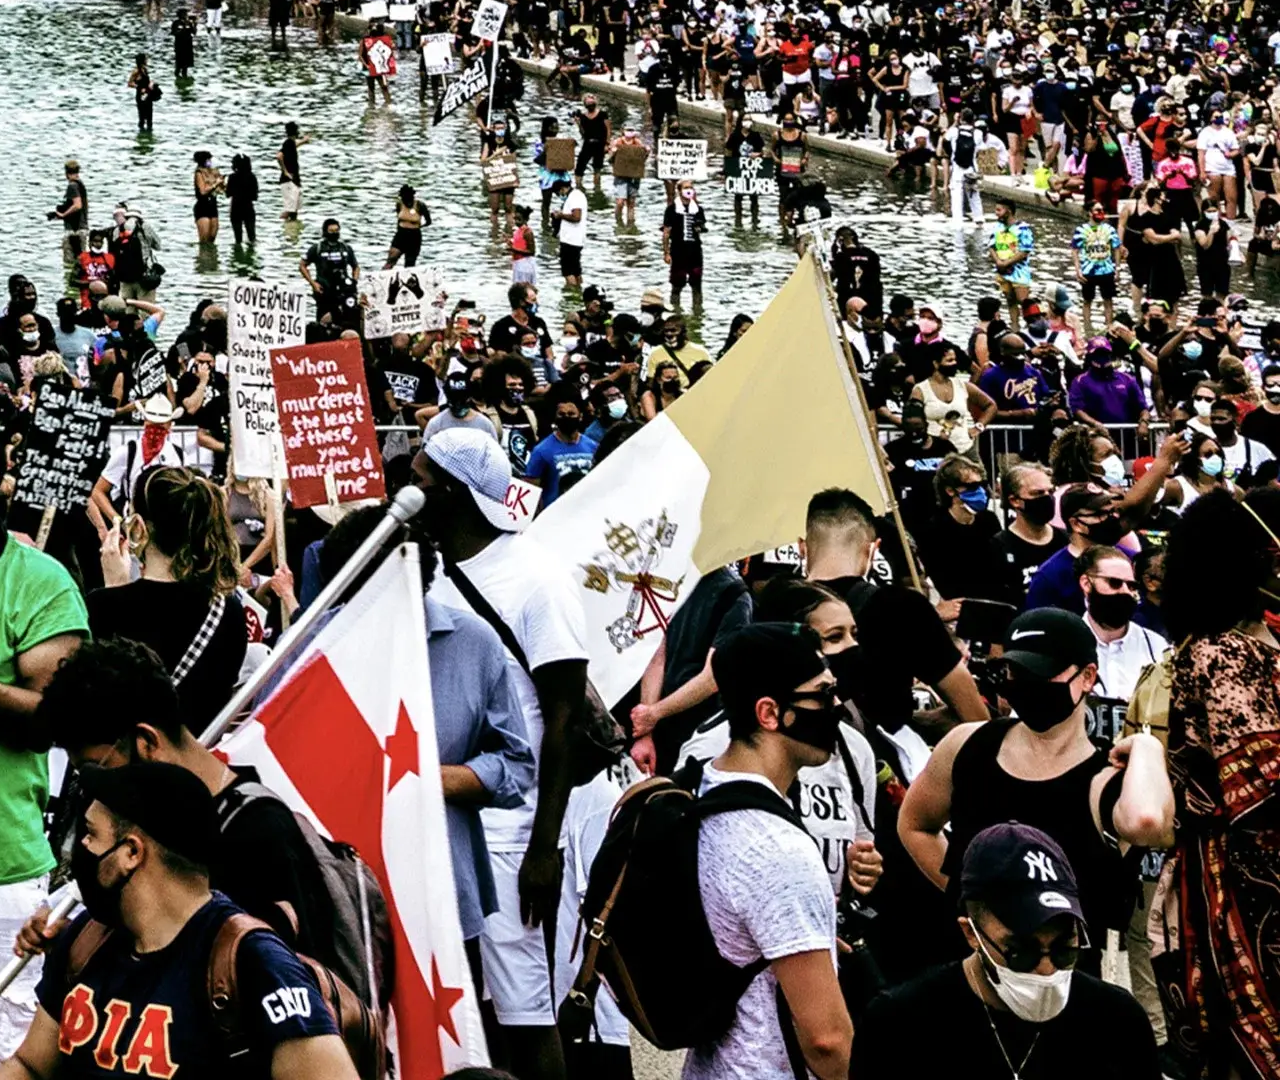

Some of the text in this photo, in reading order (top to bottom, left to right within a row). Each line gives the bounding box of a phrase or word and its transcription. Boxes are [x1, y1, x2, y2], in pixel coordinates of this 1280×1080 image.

[236, 312, 303, 337] is TOO BIG
[391, 310, 421, 324] BETTER
[248, 331, 286, 345] when it
[231, 342, 267, 361] Shoots
[39, 383, 66, 406] Ban
[314, 373, 348, 394] you
[236, 390, 276, 413] Defund
[282, 382, 365, 414] murdered
[34, 407, 61, 429] Ban
[245, 411, 276, 432] Police
[292, 406, 364, 431] the least
[287, 430, 305, 449] of
[25, 448, 87, 473] The next
[291, 446, 375, 479] murdered
[317, 445, 349, 464] you
[505, 484, 531, 516] CK
